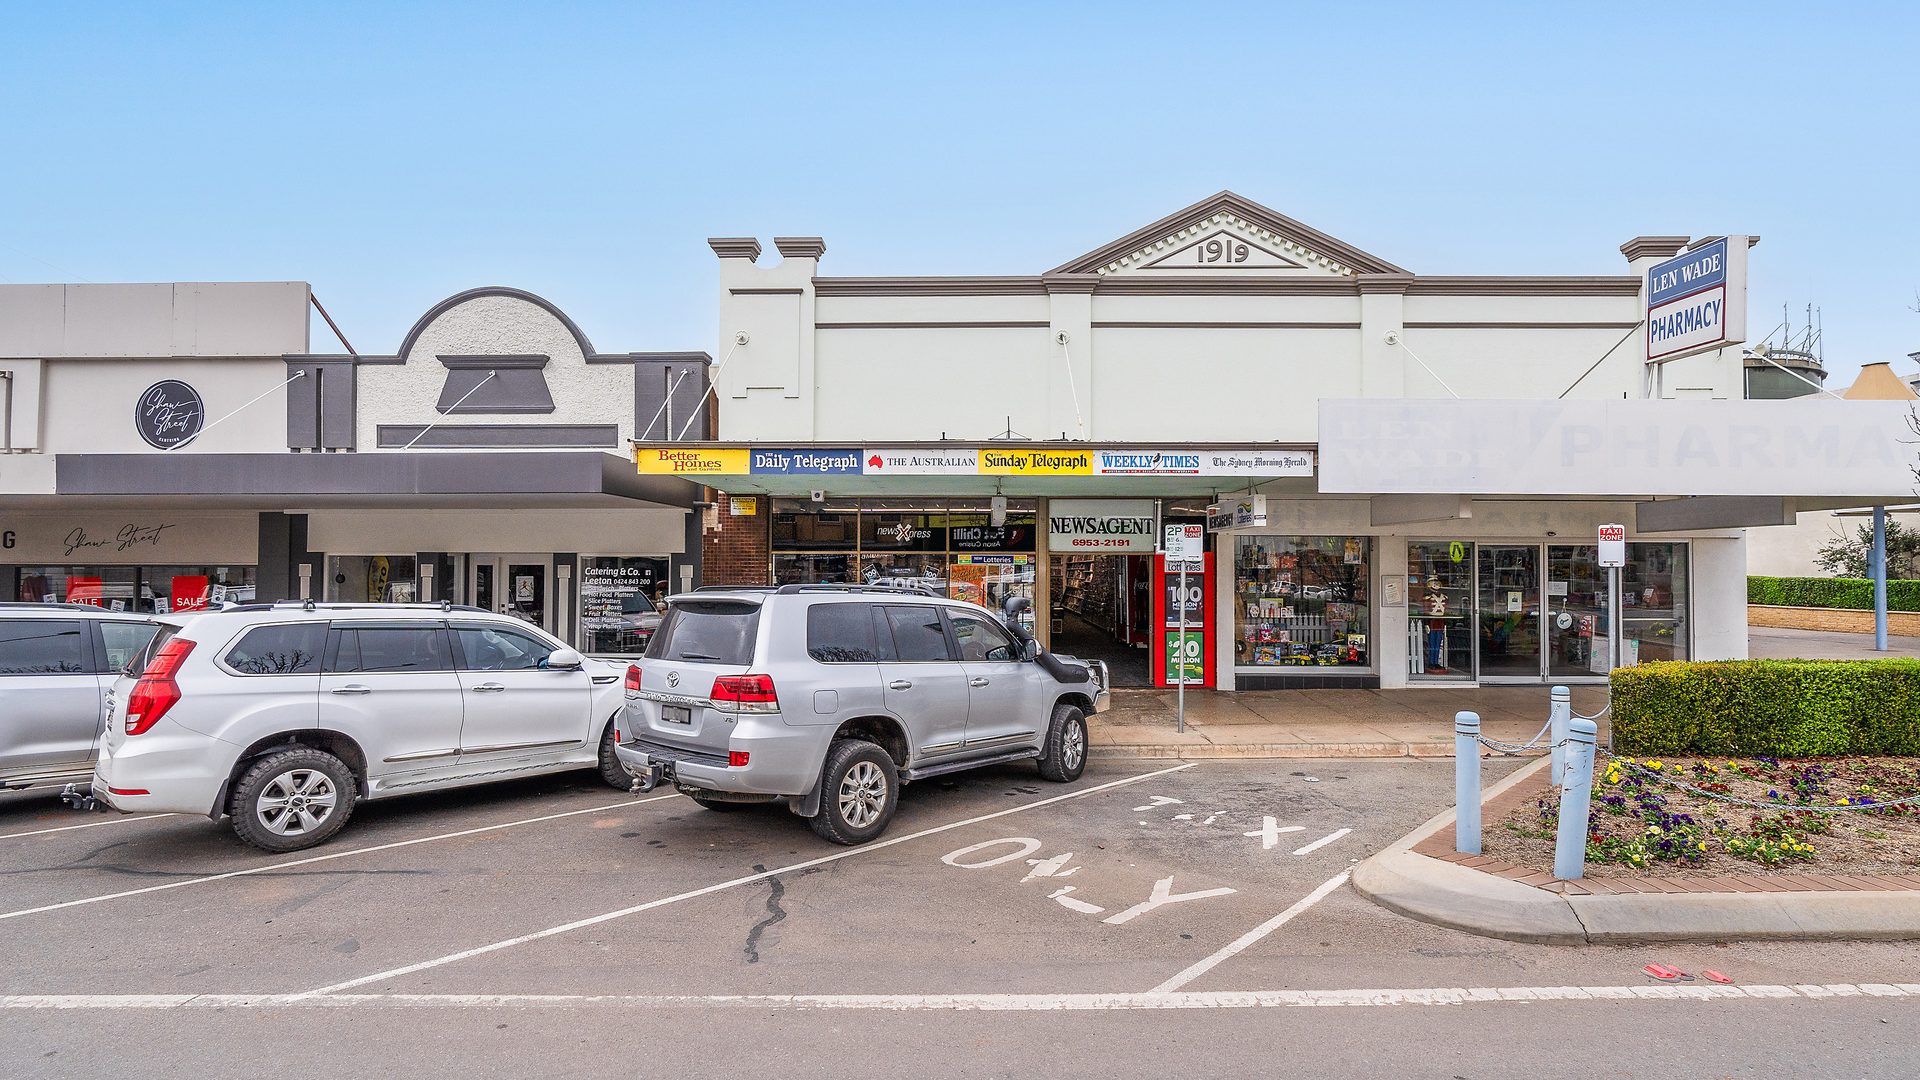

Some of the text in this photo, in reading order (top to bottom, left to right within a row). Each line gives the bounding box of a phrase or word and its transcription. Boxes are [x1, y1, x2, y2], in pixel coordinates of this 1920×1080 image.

[1198, 240, 1249, 262] 1919
[1652, 253, 1720, 294] LEN WADE
[1651, 298, 1722, 343] PHARMACY
[146, 388, 198, 416] Shaw
[154, 408, 200, 435] Street
[658, 450, 701, 461] Better
[887, 456, 976, 467] THE AUSTRALIAN
[985, 453, 1087, 470] Sunday Telegraph
[1102, 455, 1200, 468] WEEKLY TIMES
[1212, 457, 1308, 468] The Sydney Morning Herald
[673, 460, 722, 471] Homes
[755, 454, 858, 473] Daily Telegraph
[877, 522, 932, 542] newsXpress
[1050, 517, 1154, 534] NEWSAGENT
[1167, 527, 1182, 535] 2P
[3, 531, 16, 548] G
[64, 523, 175, 556] Shaw Street
[1072, 539, 1130, 547] 6953-2191
[585, 567, 641, 577] Catering & Co.
[585, 577, 612, 585] Leeton
[71, 598, 98, 607] SALE
[176, 597, 204, 606] SALE
